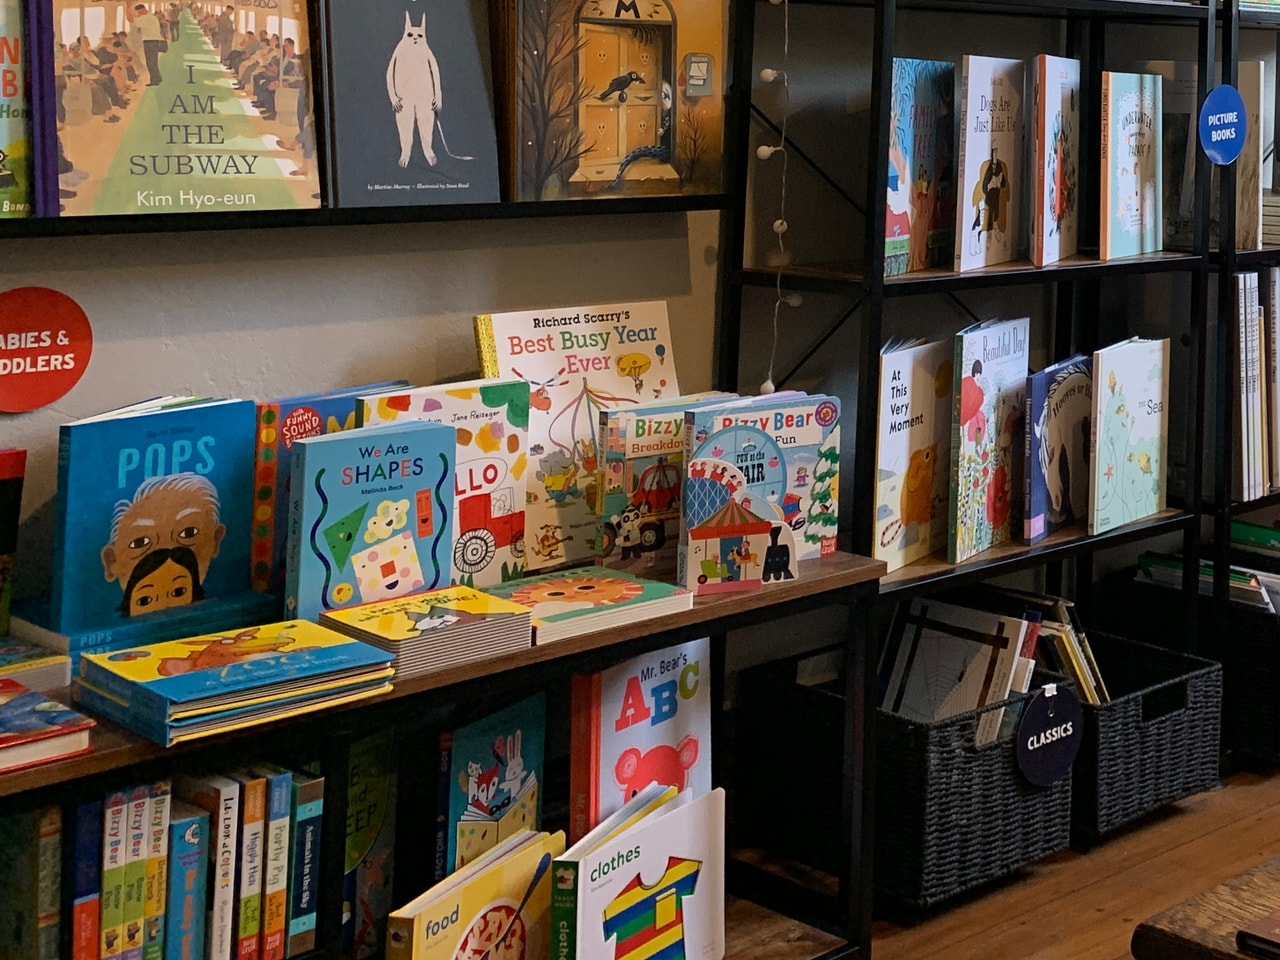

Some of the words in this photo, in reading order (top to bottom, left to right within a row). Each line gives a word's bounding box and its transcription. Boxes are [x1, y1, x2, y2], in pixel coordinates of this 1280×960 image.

[186, 65, 196, 84] I
[168, 94, 217, 114] AM
[980, 95, 996, 114] Dogs
[998, 96, 1011, 113] Are
[974, 115, 990, 133] Just
[991, 116, 1006, 133] Like
[1007, 117, 1017, 133] Us
[1121, 110, 1153, 132] UNDERWATER
[1208, 111, 1238, 127] PICTURE
[162, 125, 225, 144] THE
[1211, 128, 1236, 142] BOOKS
[130, 155, 258, 175] SUBWAY
[137, 191, 172, 207] Kim
[179, 190, 256, 209] Hyo-eun
[533, 313, 580, 328] Richard
[584, 311, 630, 324] Scarry's
[56, 330, 70, 346] &
[508, 334, 555, 355] Best
[560, 328, 611, 351] Busy
[613, 325, 657, 344] Year
[982, 333, 1012, 364] Beautiful
[565, 355, 612, 374] Ever
[891, 369, 901, 383] At
[891, 387, 908, 400] This
[1052, 385, 1077, 419] Hooves
[890, 403, 910, 418] Very
[1147, 398, 1163, 416] Sea
[281, 419, 320, 437] SOUND
[286, 412, 314, 427] FUNNY
[450, 413, 469, 423] Jane
[635, 418, 684, 438] Bizzy
[774, 412, 813, 432] Bear
[889, 414, 923, 435] Moment
[359, 445, 382, 459] We
[385, 443, 409, 456] Are
[736, 453, 749, 464] FUN
[117, 435, 216, 489] POPS
[341, 458, 424, 486] SHAPES
[361, 486, 389, 495] Melinda
[390, 484, 404, 492] Beck
[79, 631, 113, 647] POPS
[640, 665, 657, 682] Mr.
[659, 652, 688, 675] Bear's
[615, 660, 700, 733] ABC
[1027, 722, 1073, 750] CLASSICS
[132, 801, 146, 831] Bizzy
[152, 797, 166, 827] Bizzy
[110, 807, 123, 838] Bizzy
[132, 832, 144, 858] Bear
[152, 828, 165, 854] Bear
[247, 831, 260, 865] Higgly
[270, 825, 285, 862] Portly
[302, 825, 314, 863] Animals
[109, 839, 122, 865] Bear
[590, 845, 641, 883] clothes
[248, 866, 259, 887] Hen
[269, 866, 284, 886] Pig
[302, 876, 312, 891] the
[299, 891, 311, 909] Sky
[425, 904, 460, 940] food
